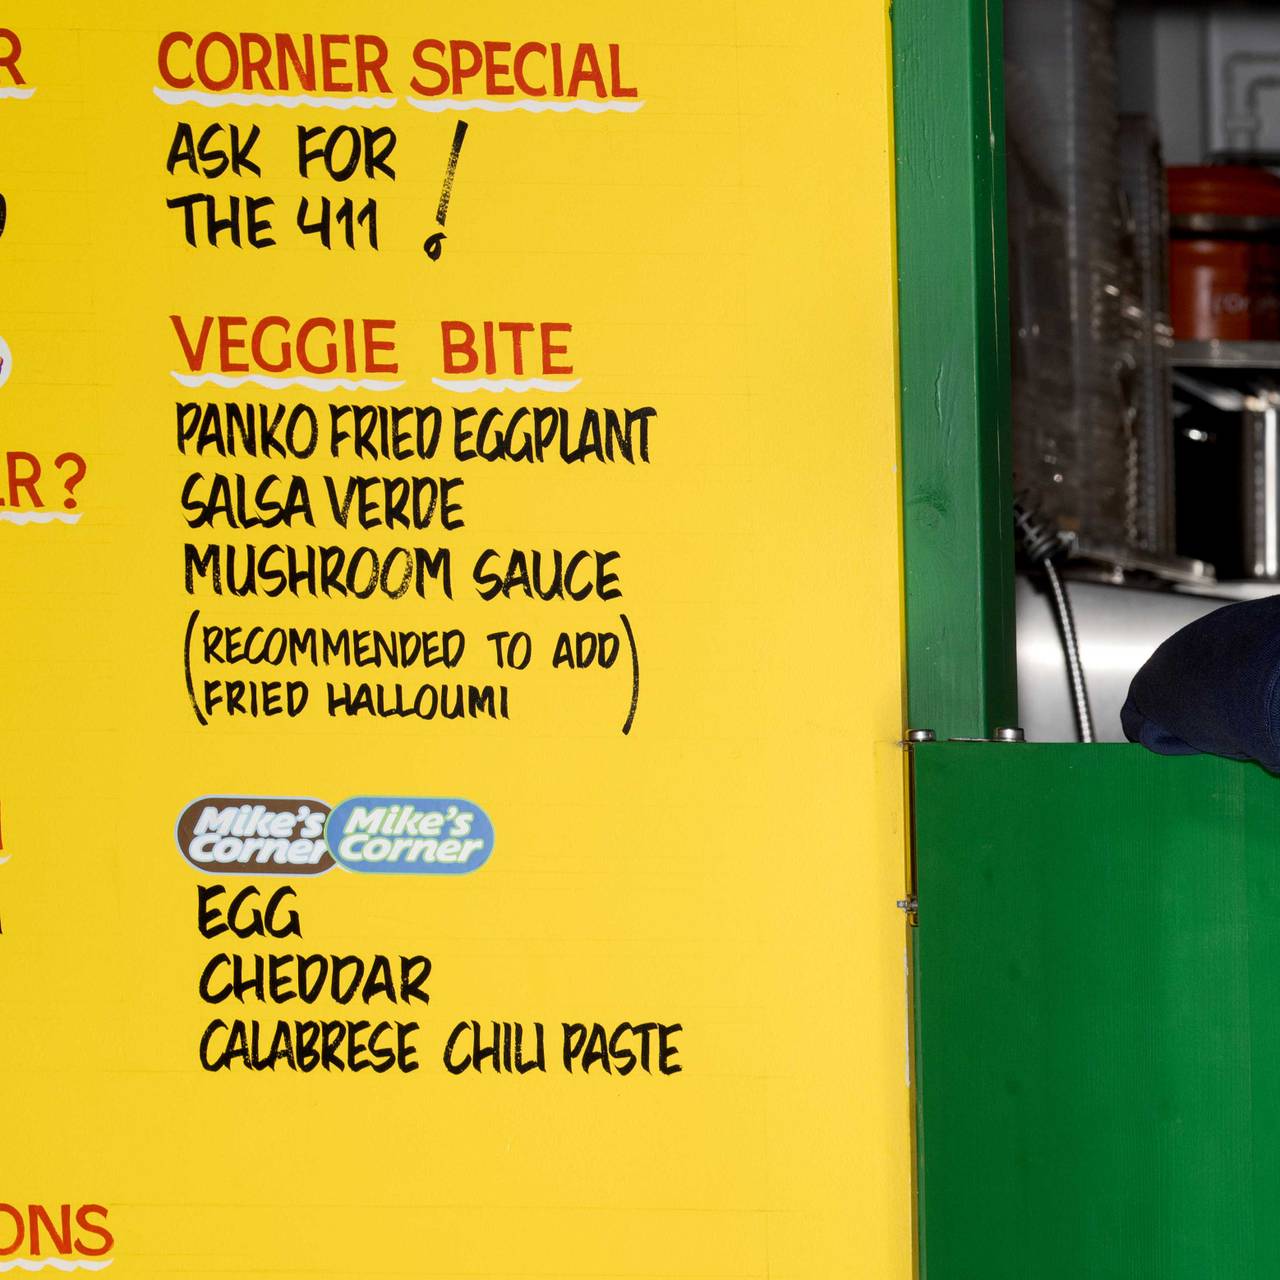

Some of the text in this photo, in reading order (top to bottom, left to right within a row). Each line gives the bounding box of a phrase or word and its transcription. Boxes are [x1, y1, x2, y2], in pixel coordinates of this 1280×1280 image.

[158, 31, 638, 98] CORNER SPECIAL
[167, 122, 261, 178] ASK
[298, 125, 397, 181] FOR
[167, 193, 379, 251] THE 411
[170, 315, 573, 375] VEGGIE BITE
[176, 403, 657, 465] PANKO FRIED EGGPLANT
[182, 473, 465, 531] SALSA VERDE
[185, 544, 623, 602] MUSHROOM SAUCE
[487, 632, 532, 669] TO
[204, 681, 509, 721] FRIED HALLOUMI
[188, 833, 330, 865] Corner
[193, 805, 326, 838] Mike's
[337, 834, 484, 864] Corner
[343, 805, 474, 837] Mike's
[198, 885, 303, 940] EGG
[199, 953, 432, 1005] CHEDDAR
[200, 1019, 683, 1076] CALABRESE CHILI PASTE
